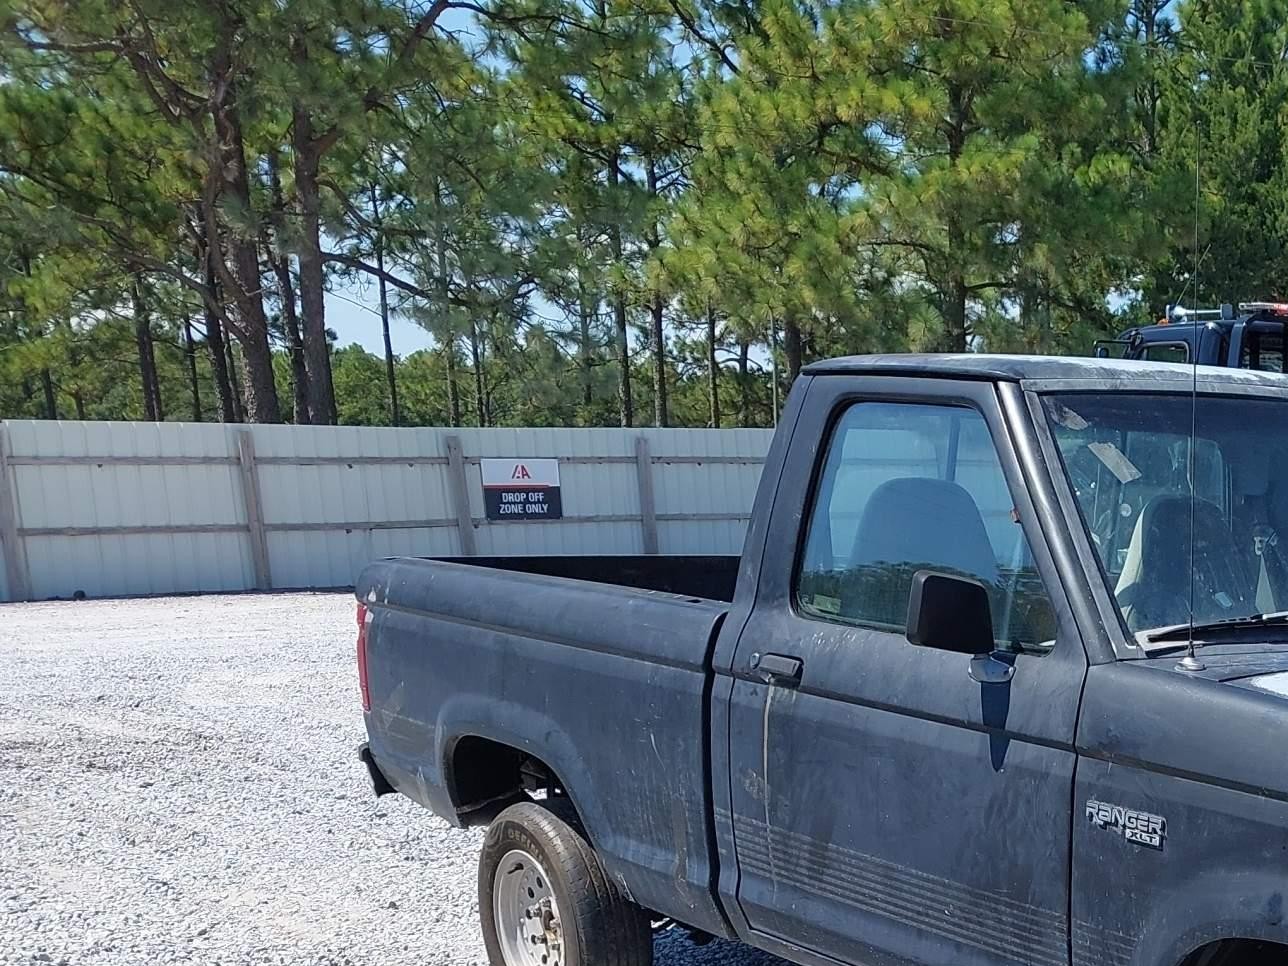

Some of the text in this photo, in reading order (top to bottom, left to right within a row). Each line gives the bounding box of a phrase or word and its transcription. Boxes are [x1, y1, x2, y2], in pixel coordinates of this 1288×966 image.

[502, 492, 545, 503] DROP OFF
[499, 503, 549, 514] ZONE ONLY
[1128, 830, 1157, 844] XLT
